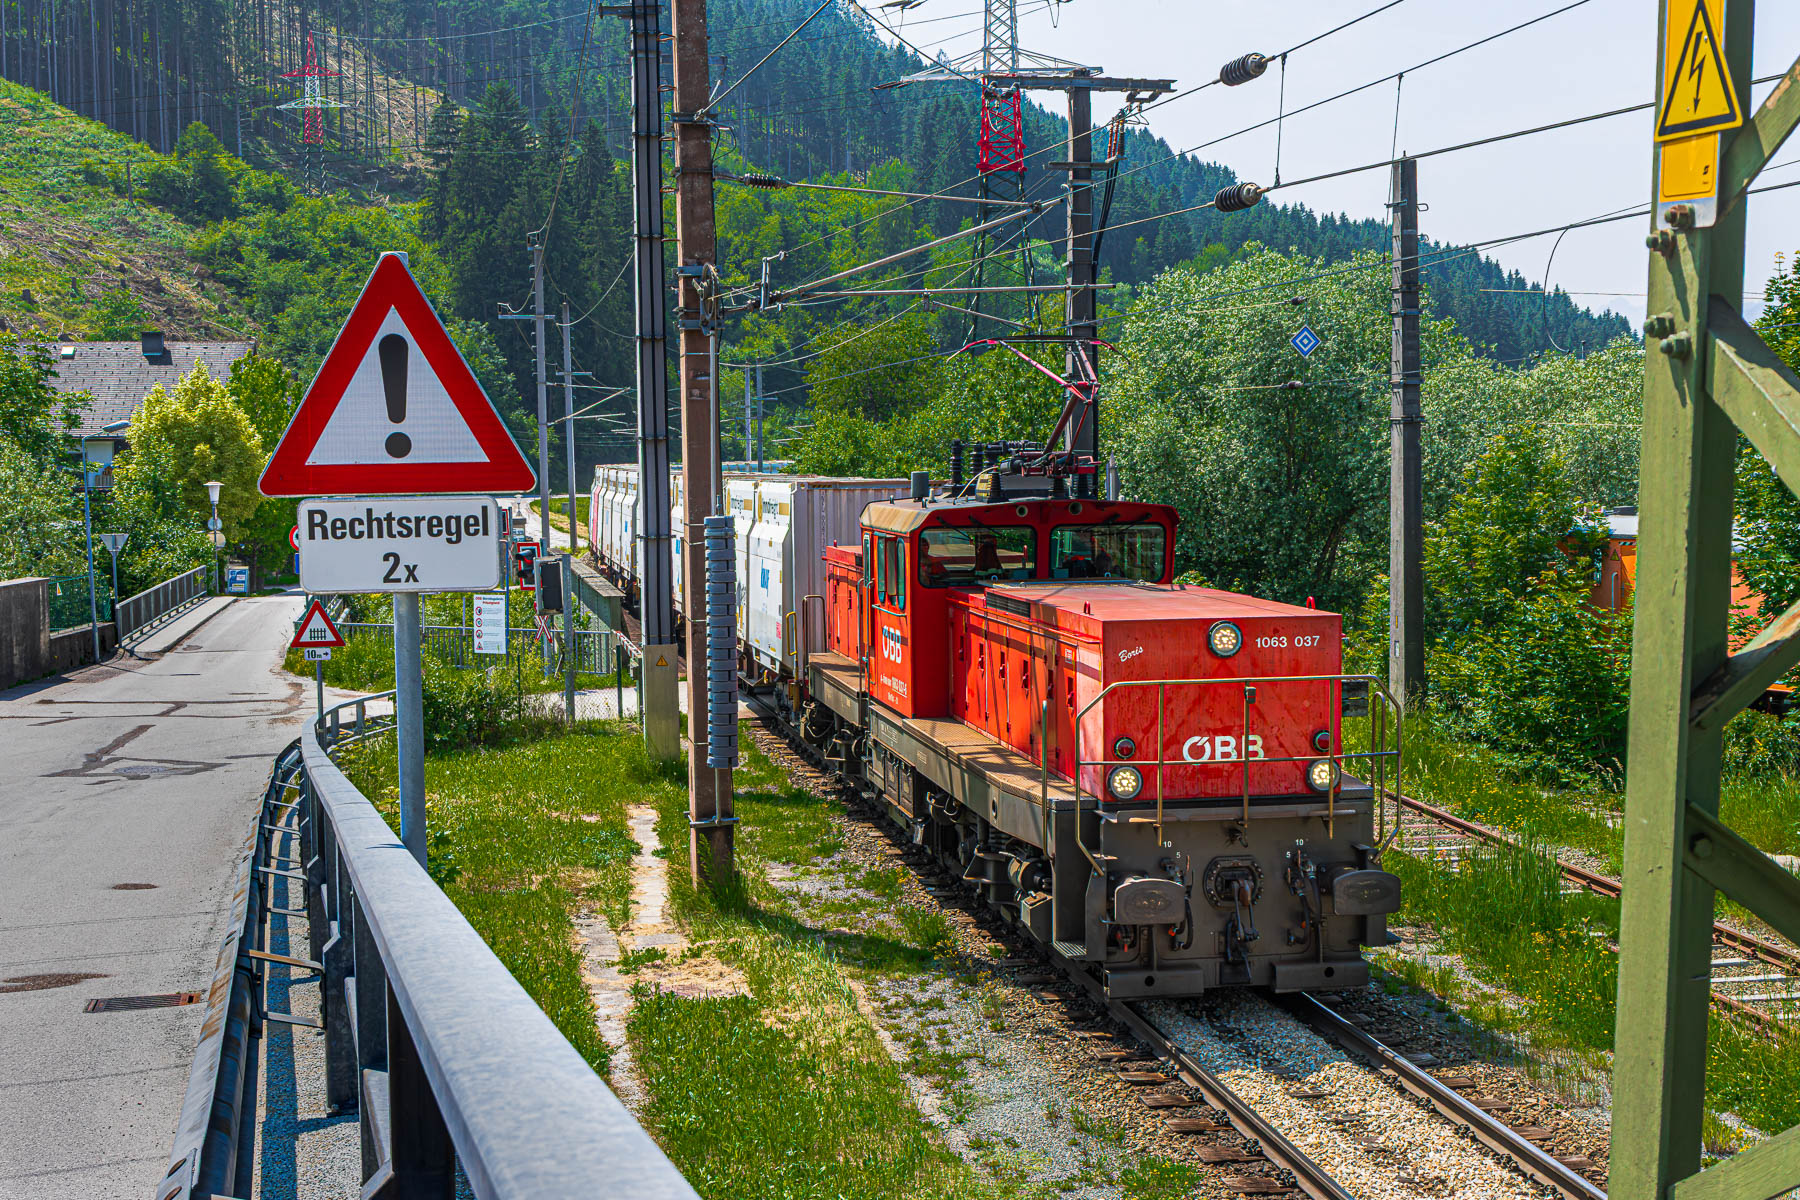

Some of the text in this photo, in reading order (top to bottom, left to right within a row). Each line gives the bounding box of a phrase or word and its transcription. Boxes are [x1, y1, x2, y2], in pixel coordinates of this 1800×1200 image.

[307, 506, 489, 544] Rechtsregel
[382, 552, 419, 583] 2x
[882, 625, 902, 664] ÖBB
[1255, 635, 1320, 648] 1063 037
[1118, 646, 1143, 662] Boris
[1182, 735, 1265, 765] ÖBB
[1163, 840, 1172, 848] 10
[1295, 838, 1304, 846] 10
[1175, 851, 1181, 859] 5
